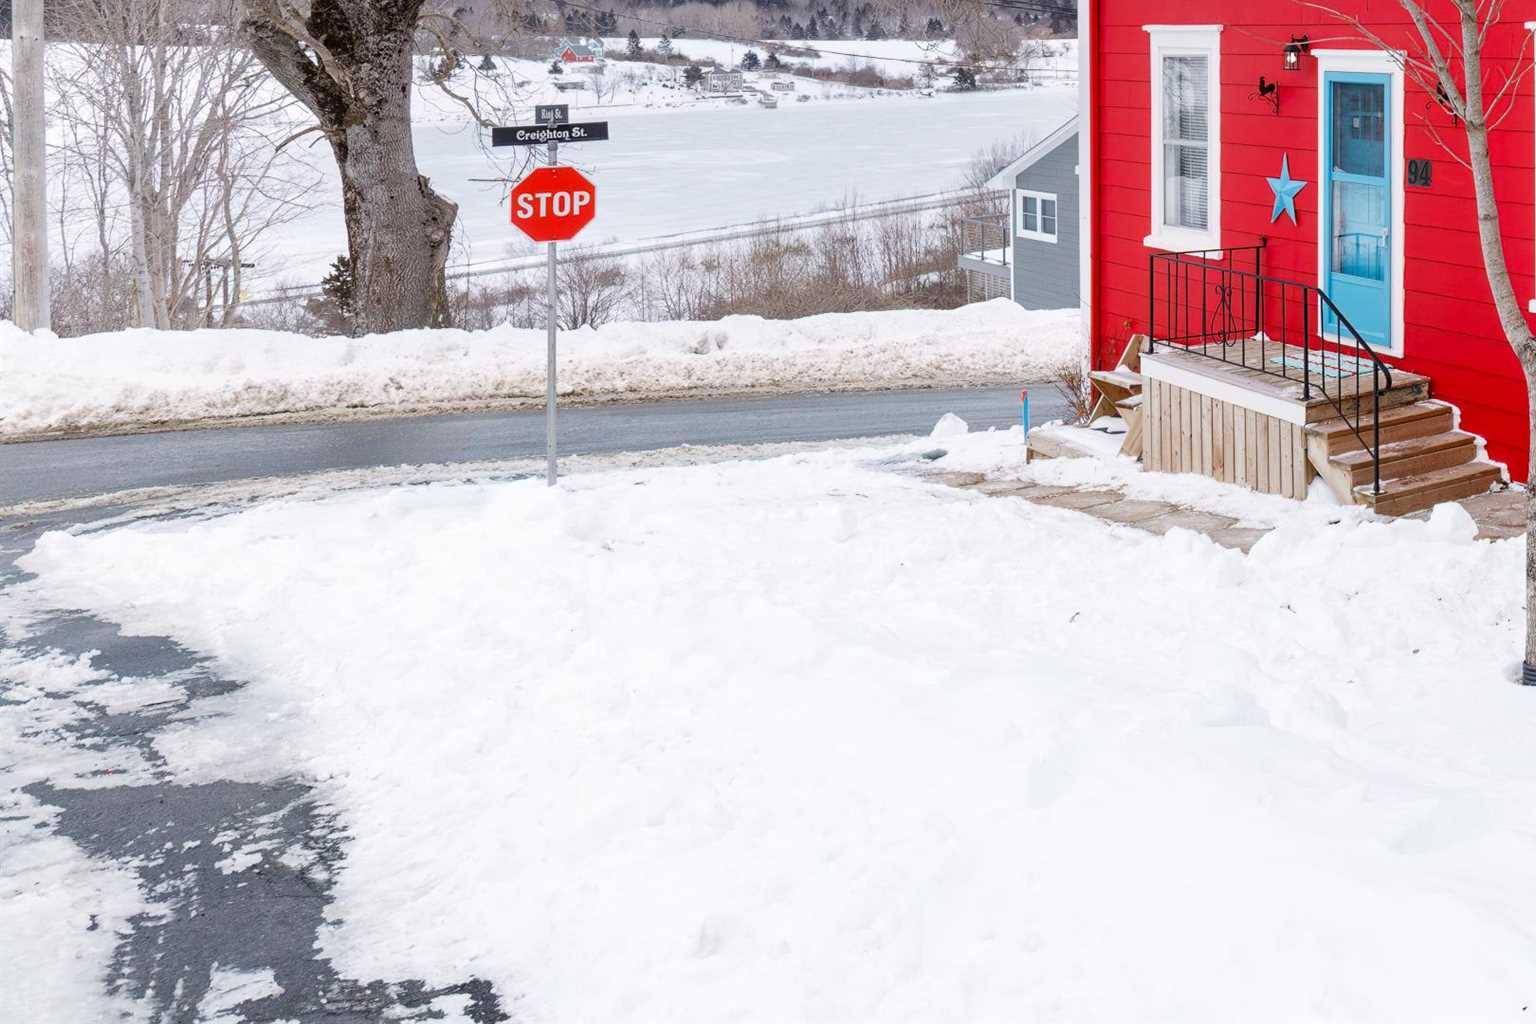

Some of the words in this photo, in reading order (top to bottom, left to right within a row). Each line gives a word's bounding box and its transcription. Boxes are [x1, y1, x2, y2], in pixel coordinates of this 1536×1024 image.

[516, 129, 571, 143] Creighton
[571, 126, 588, 138] St.
[1408, 159, 1431, 186] 94
[516, 191, 591, 219] STOP
